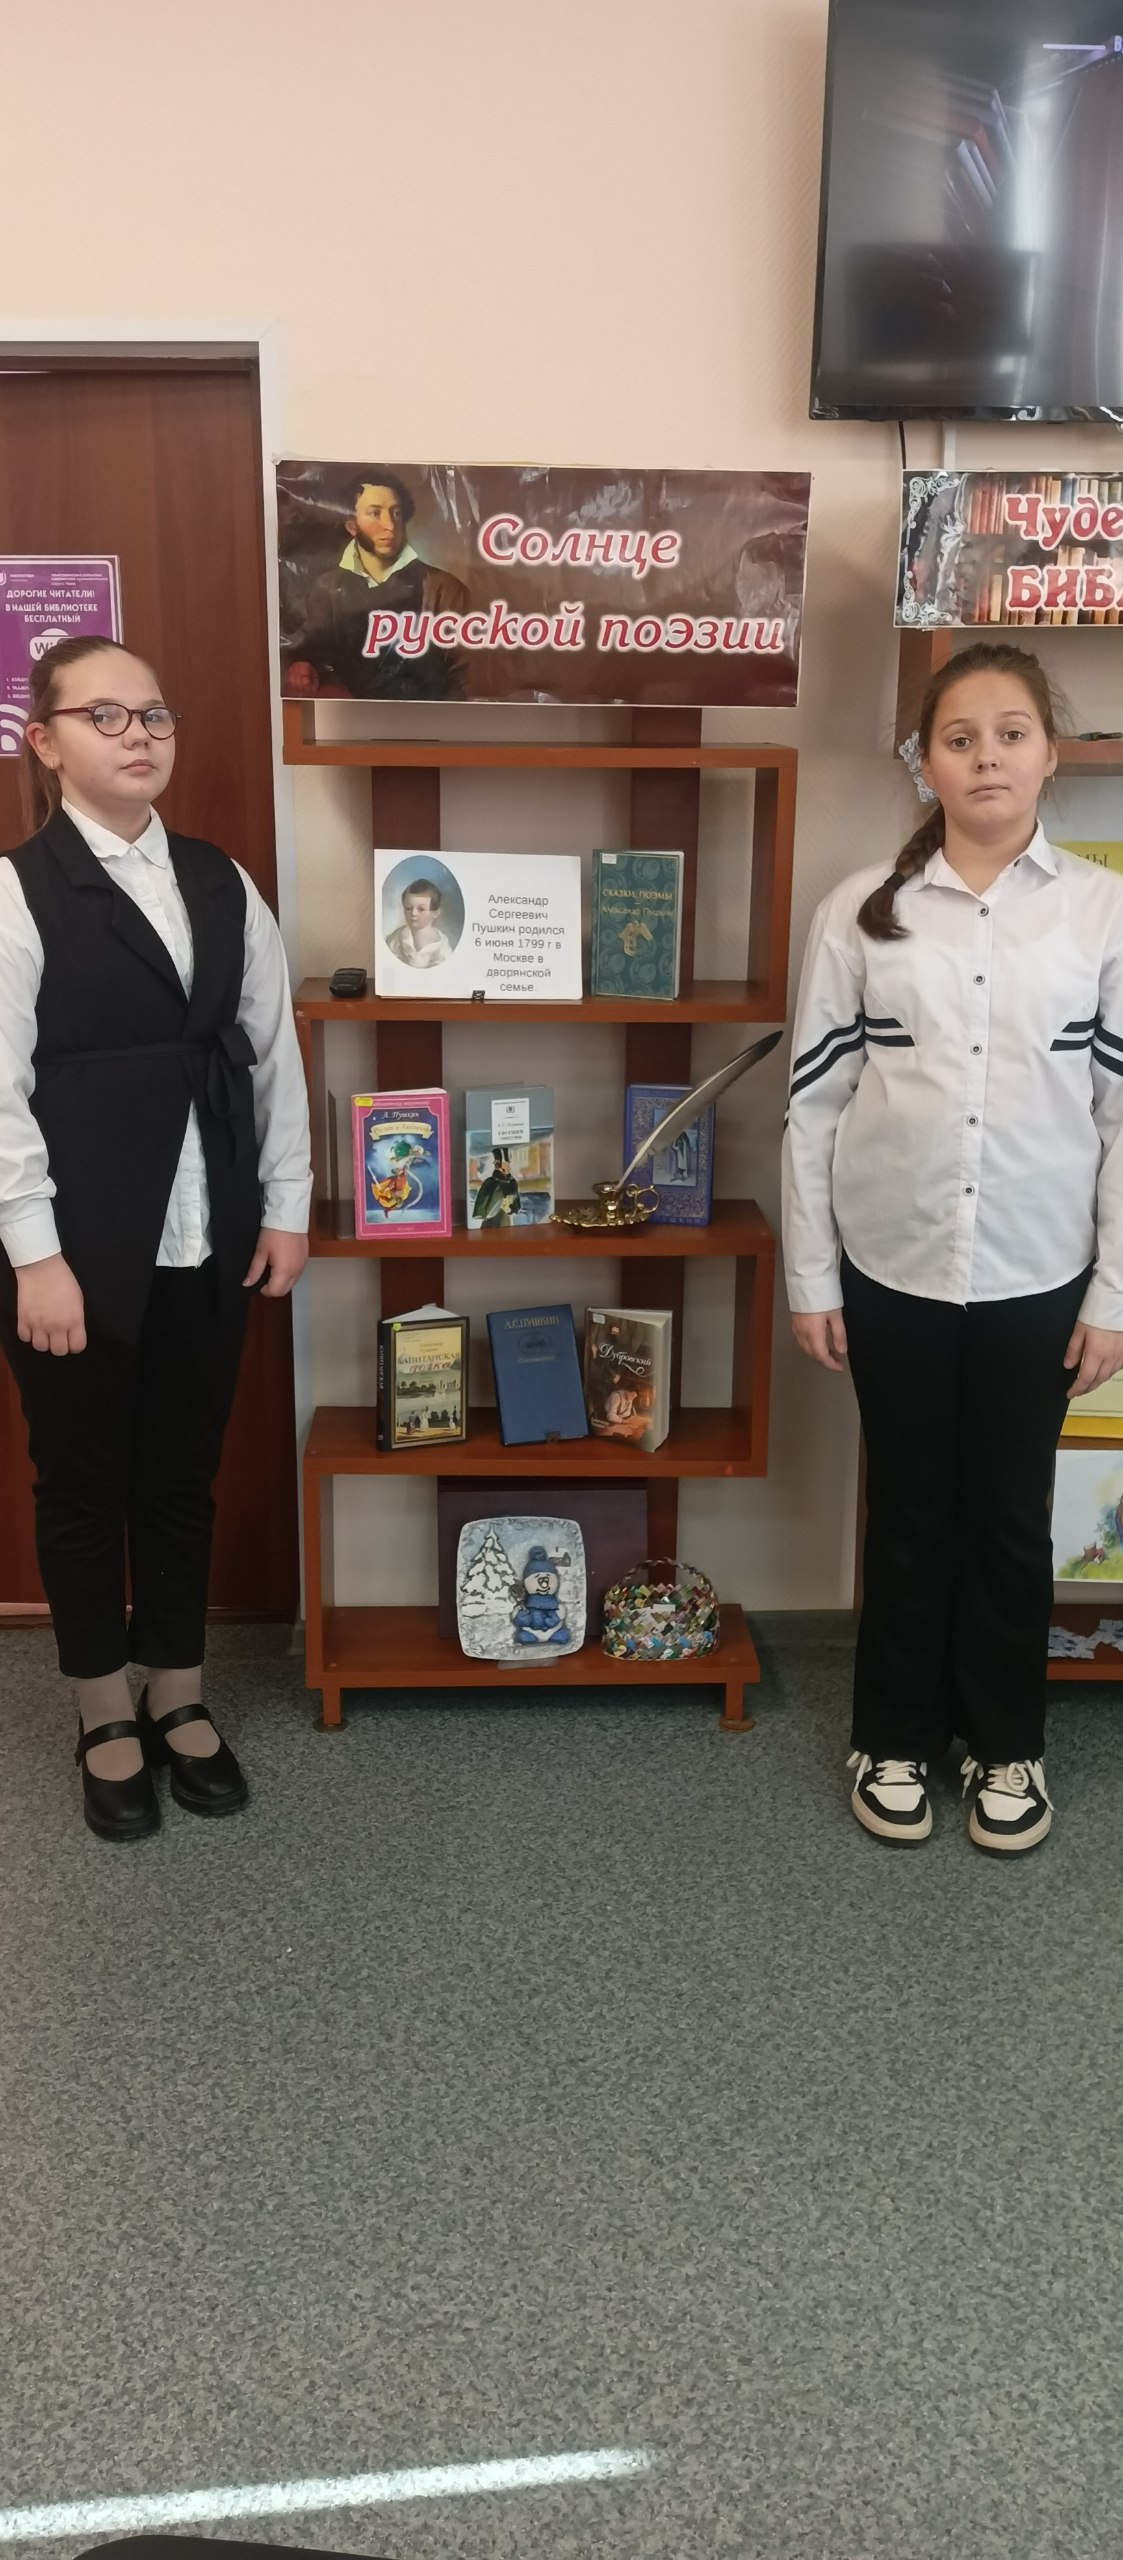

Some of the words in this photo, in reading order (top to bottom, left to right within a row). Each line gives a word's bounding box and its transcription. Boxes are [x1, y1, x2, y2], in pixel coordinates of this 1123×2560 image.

[481, 515, 680, 577] Солнце
[6, 589, 47, 598] ДОРОГИЕ
[49, 589, 95, 598] ЧИТАТЕЛИ!
[5, 603, 11, 612] В
[12, 602, 42, 612] НАШЕЙ
[44, 603, 98, 612] БИБЛИОТЕКЕ
[24, 612, 81, 623] БЕСПЛАТНЫЙ
[364, 601, 586, 657] русской
[600, 614, 784, 654] поэзии
[488, 894, 549, 907] Александр
[488, 908, 548, 920] Сергеевич
[472, 922, 515, 935] Пушкин
[519, 925, 565, 936] родился
[474, 937, 482, 947] 6
[485, 939, 514, 948] июня
[518, 938, 545, 949] 1799
[547, 941, 552, 949] г
[555, 941, 562, 949] в
[493, 952, 535, 963] Москве
[537, 955, 544, 963] в
[486, 968, 551, 979] дворянской
[499, 983, 537, 992] семье.
